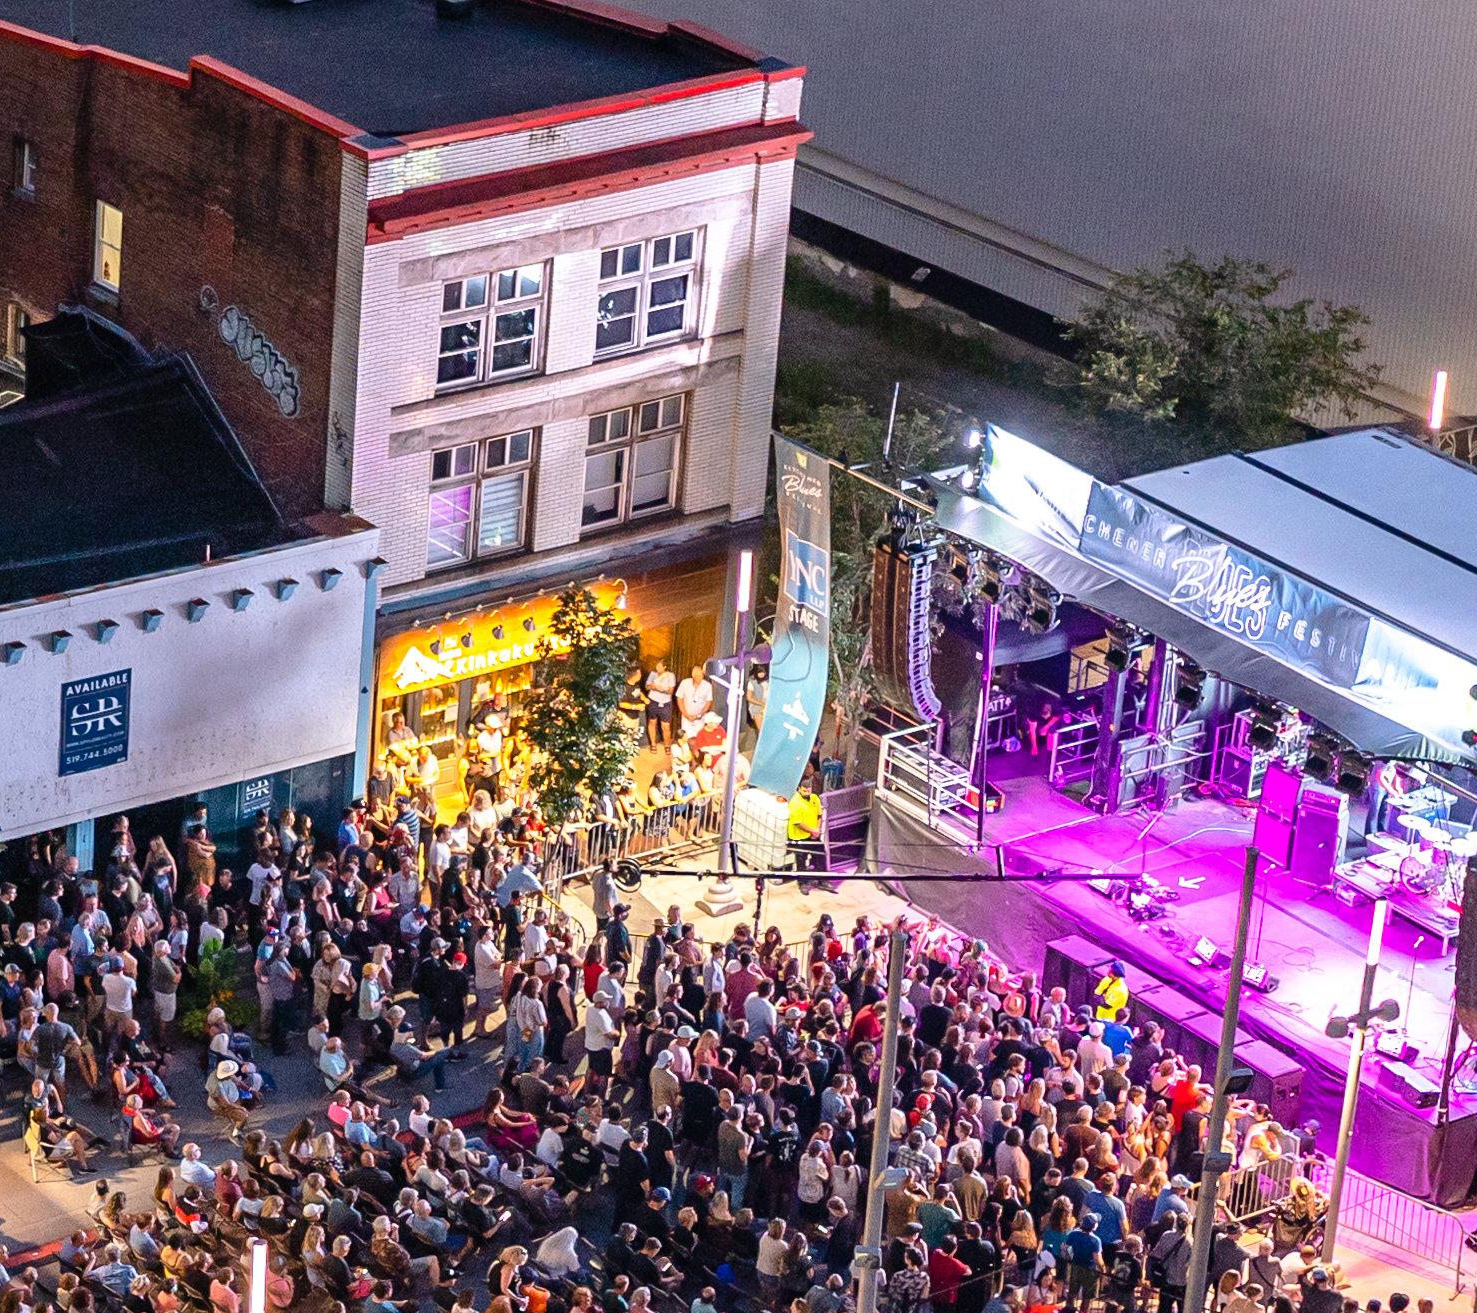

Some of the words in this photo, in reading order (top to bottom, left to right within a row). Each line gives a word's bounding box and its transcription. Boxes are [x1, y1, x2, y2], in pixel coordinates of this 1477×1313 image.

[782, 474, 823, 498] Blues
[788, 604, 819, 634] STAGE
[66, 672, 128, 696] AVAILABLE
[66, 744, 124, 765] 519.744.5000
